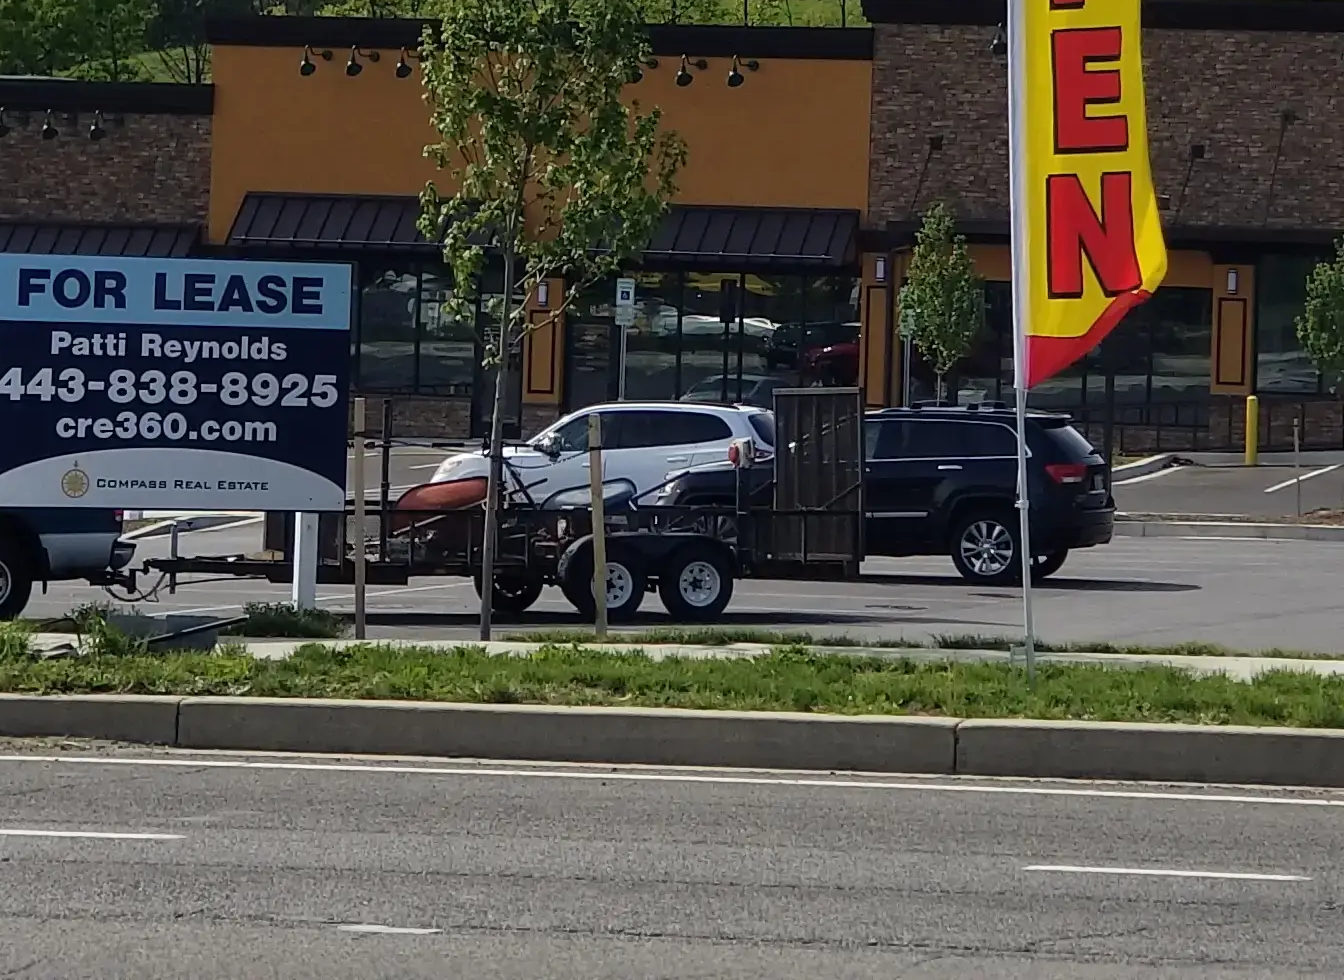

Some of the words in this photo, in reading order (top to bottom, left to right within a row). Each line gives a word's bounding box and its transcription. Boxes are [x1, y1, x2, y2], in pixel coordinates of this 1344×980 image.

[18, 267, 128, 309] FOR
[155, 272, 325, 316] LEASE
[51, 331, 126, 357] Patti
[141, 333, 288, 364] Reynolds
[56, 411, 277, 442] cre360.com
[96, 478, 167, 489] COMPASS
[174, 479, 211, 490] REAL
[217, 480, 269, 491] ESTATE
